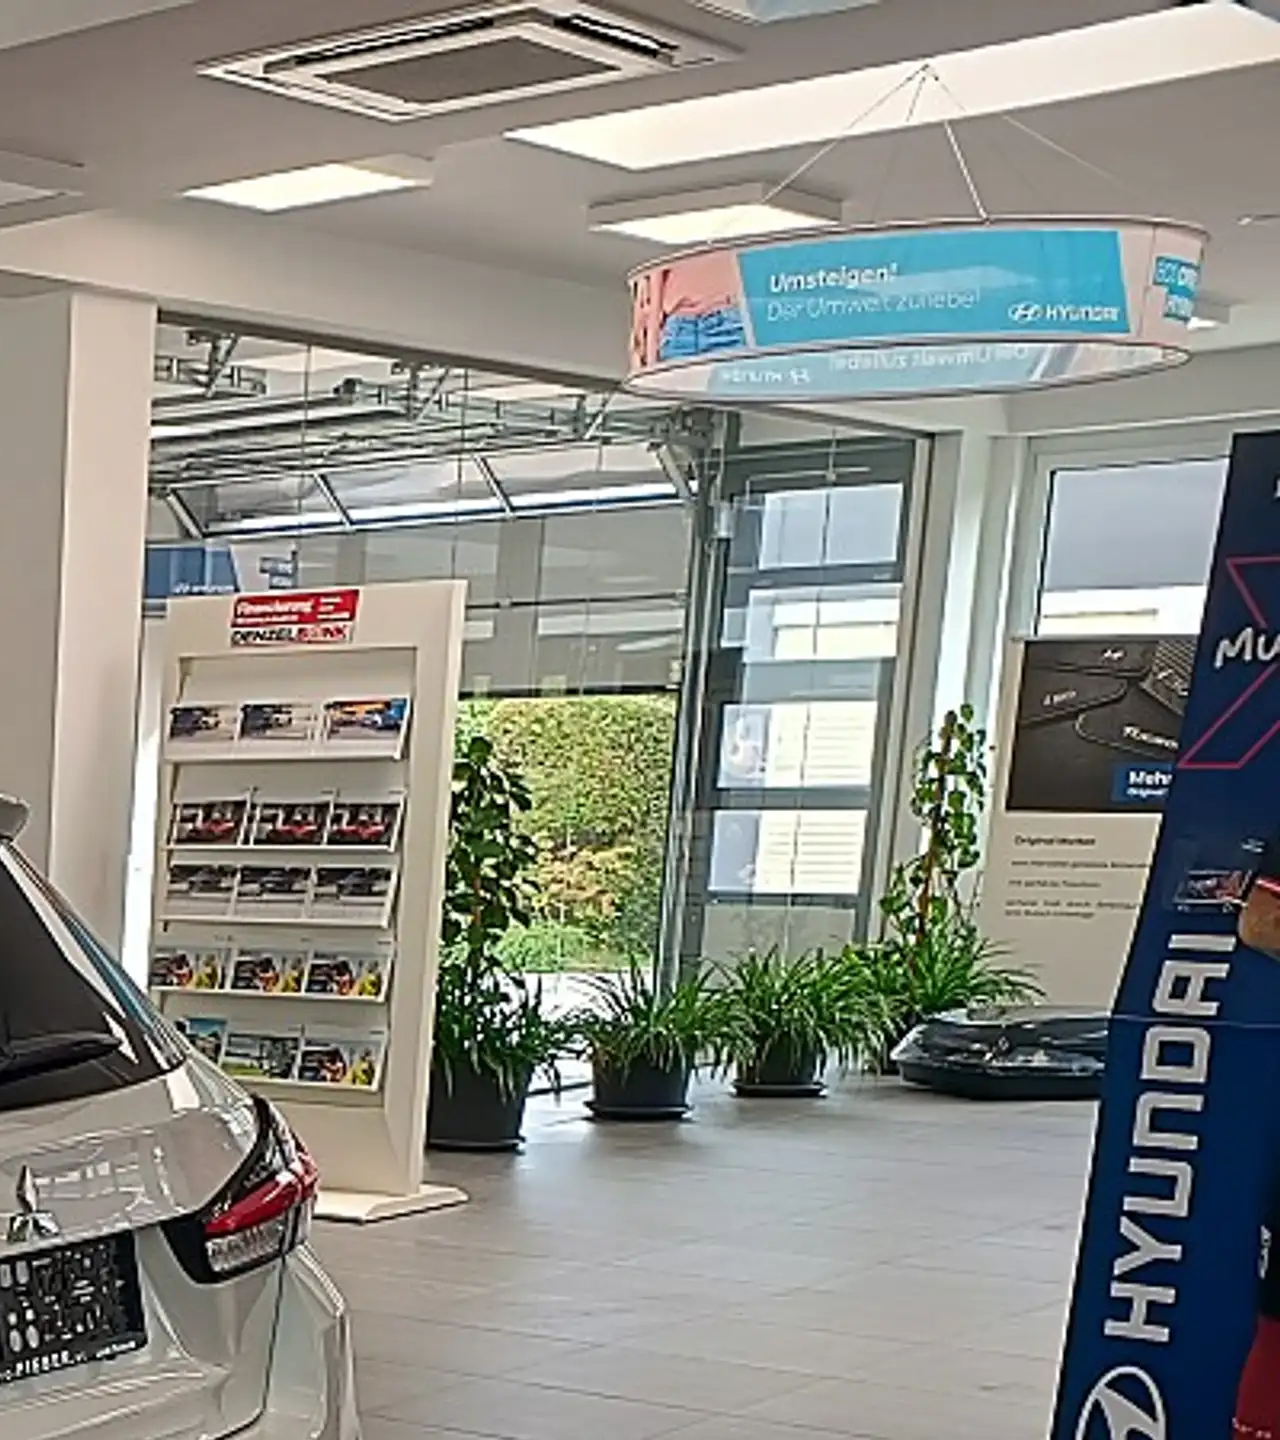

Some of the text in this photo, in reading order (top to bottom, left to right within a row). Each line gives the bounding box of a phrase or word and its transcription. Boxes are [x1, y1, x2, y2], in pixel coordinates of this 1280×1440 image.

[769, 262, 899, 293] Umsteigen!
[1044, 303, 1121, 323] HYUNDAI
[1104, 932, 1238, 1343] HYUNDAI
